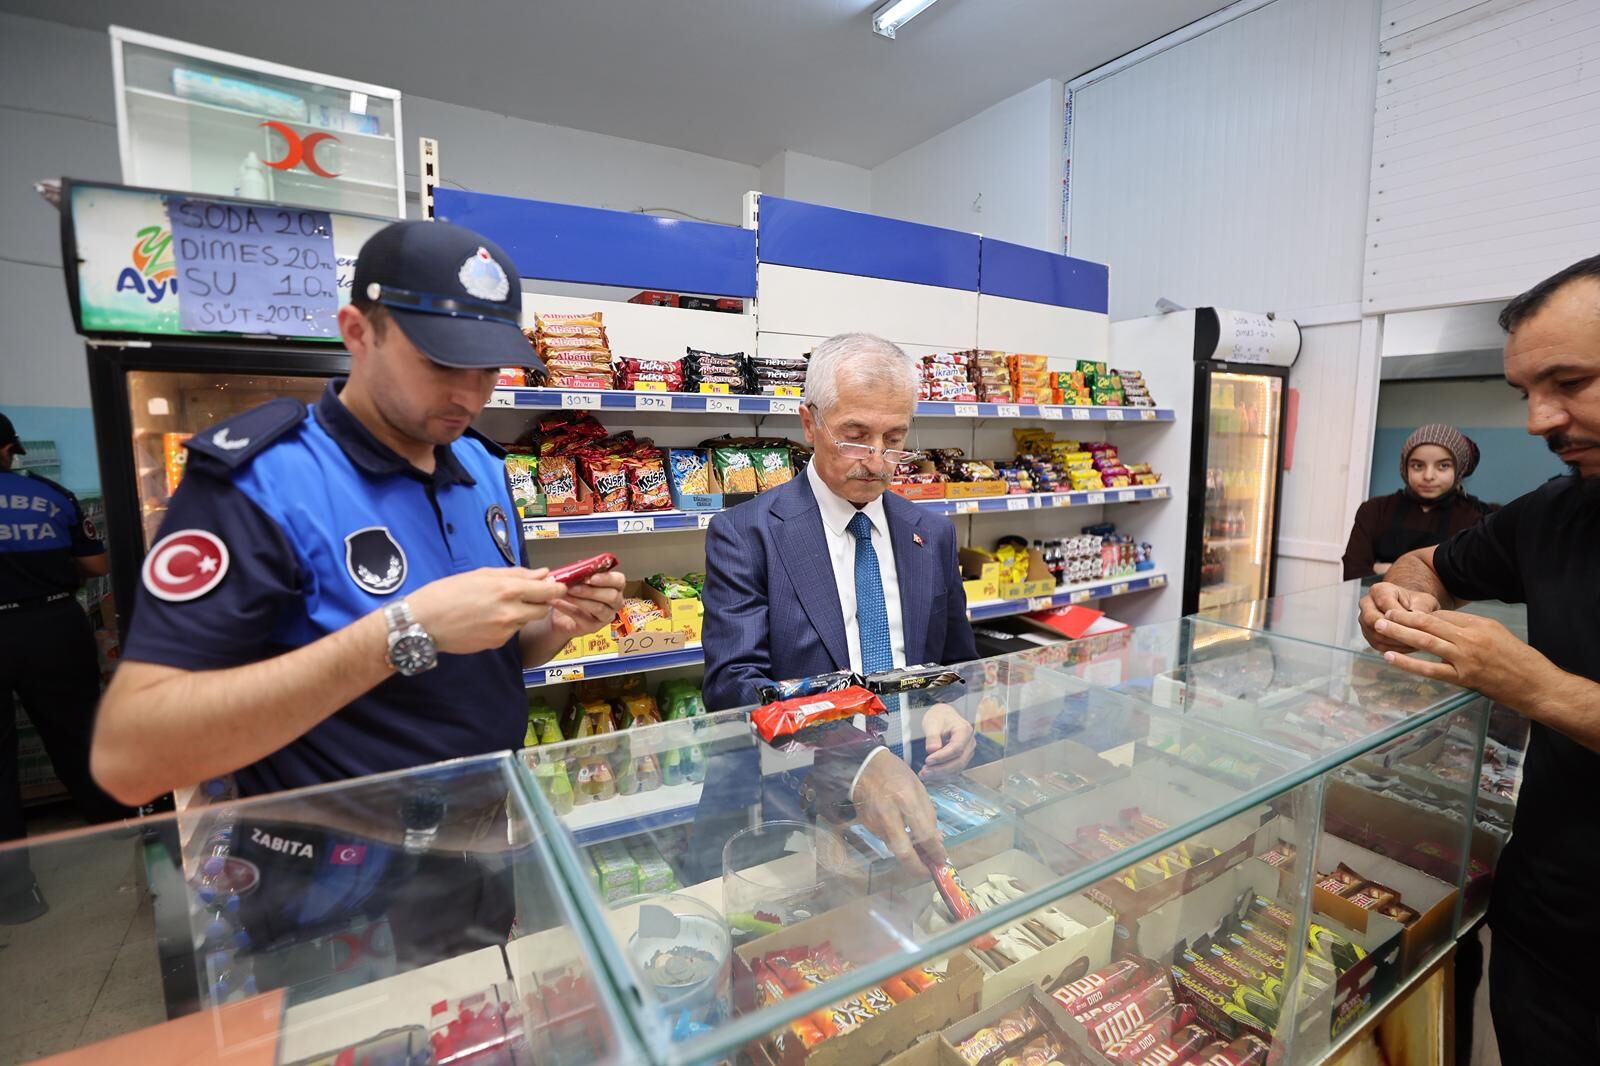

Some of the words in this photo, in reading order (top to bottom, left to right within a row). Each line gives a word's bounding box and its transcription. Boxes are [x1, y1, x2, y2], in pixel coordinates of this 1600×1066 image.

[179, 202, 264, 234] SODA
[184, 267, 237, 297] SU
[200, 302, 251, 326] SÜT
[555, 353, 592, 361] Albeni
[935, 368, 959, 377] ikram
[943, 386, 967, 395] ikram
[640, 398, 654, 407] 30
[710, 400, 723, 410] 30
[772, 402, 786, 412] 30
[623, 521, 645, 532] 20
[623, 636, 654, 654] 20
[664, 637, 680, 645] TL
[549, 669, 563, 678] 20
[250, 828, 314, 859] ZABITA
